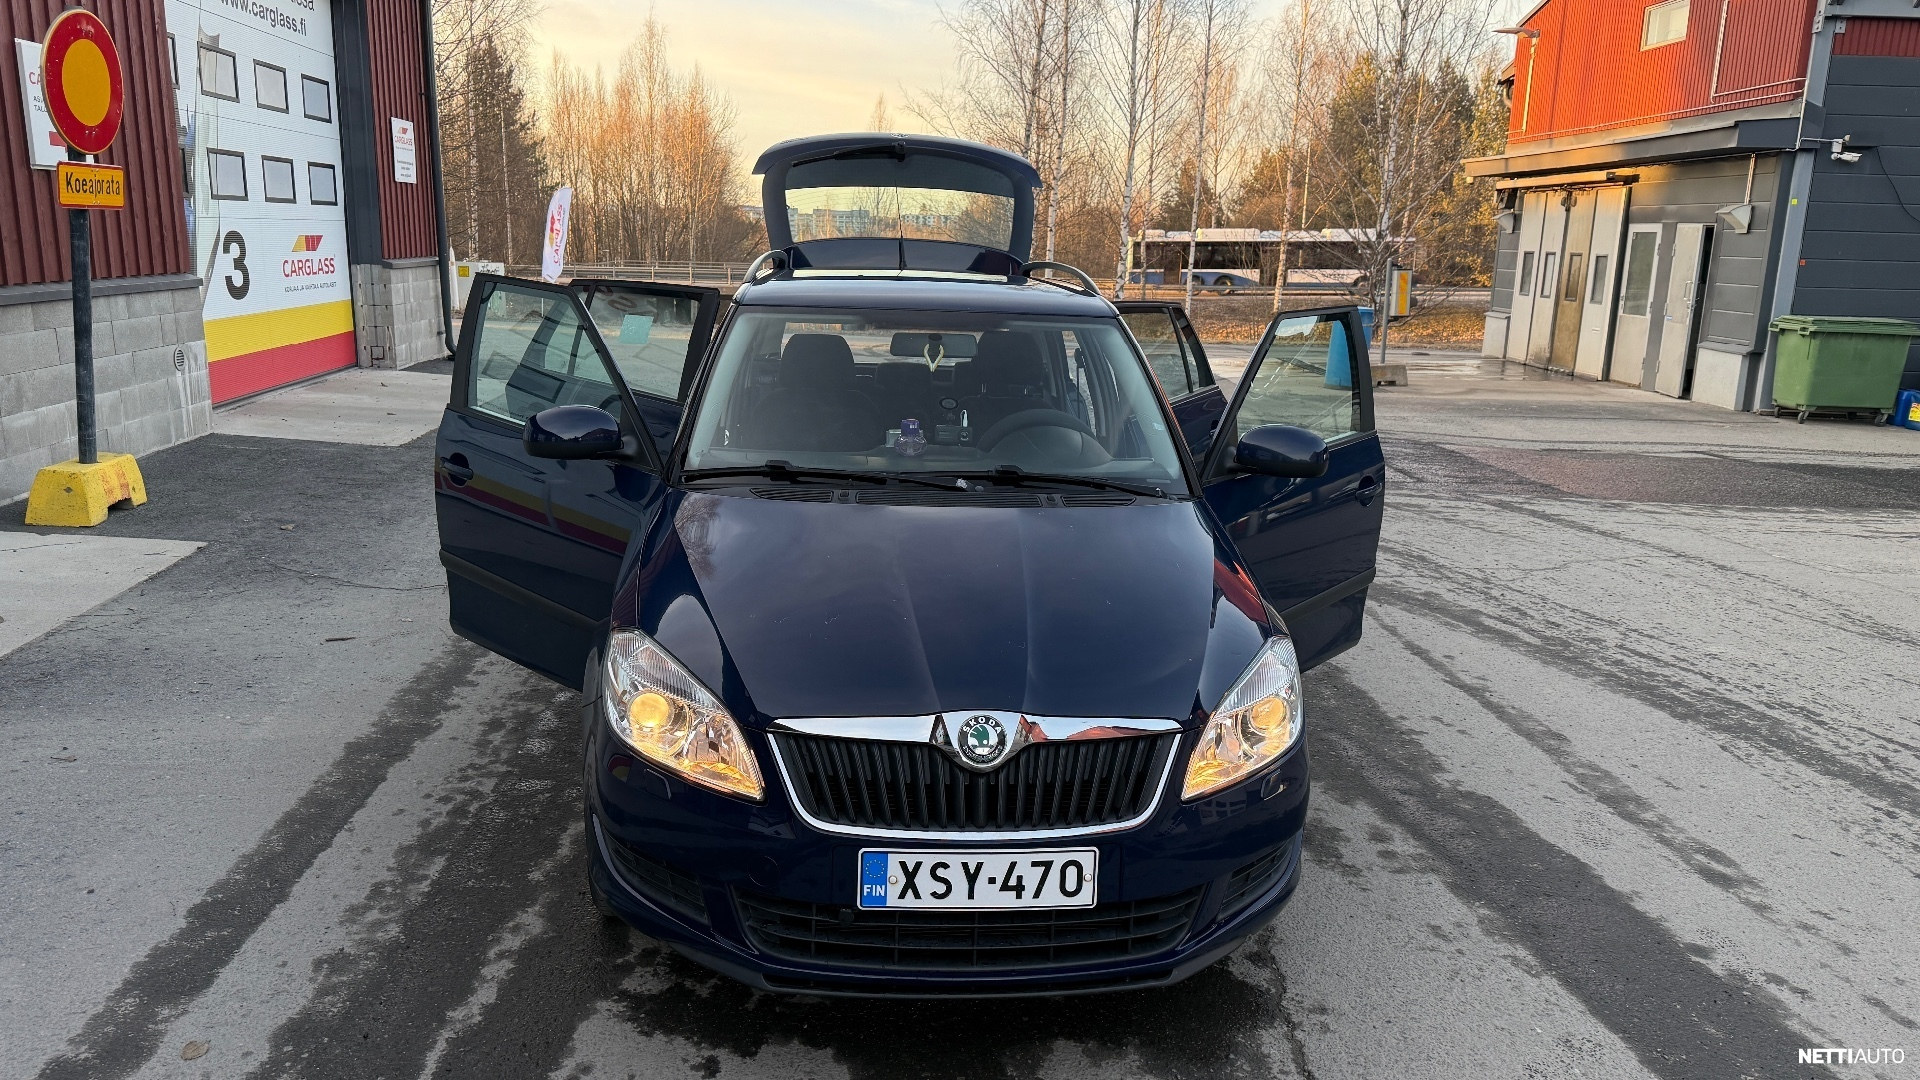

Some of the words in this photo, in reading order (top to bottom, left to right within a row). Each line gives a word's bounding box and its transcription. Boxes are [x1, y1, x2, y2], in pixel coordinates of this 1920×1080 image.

[65, 171, 120, 198] Koeajorata
[223, 230, 250, 300] 3
[282, 257, 336, 278] CARGLASS
[863, 884, 886, 897] FIN
